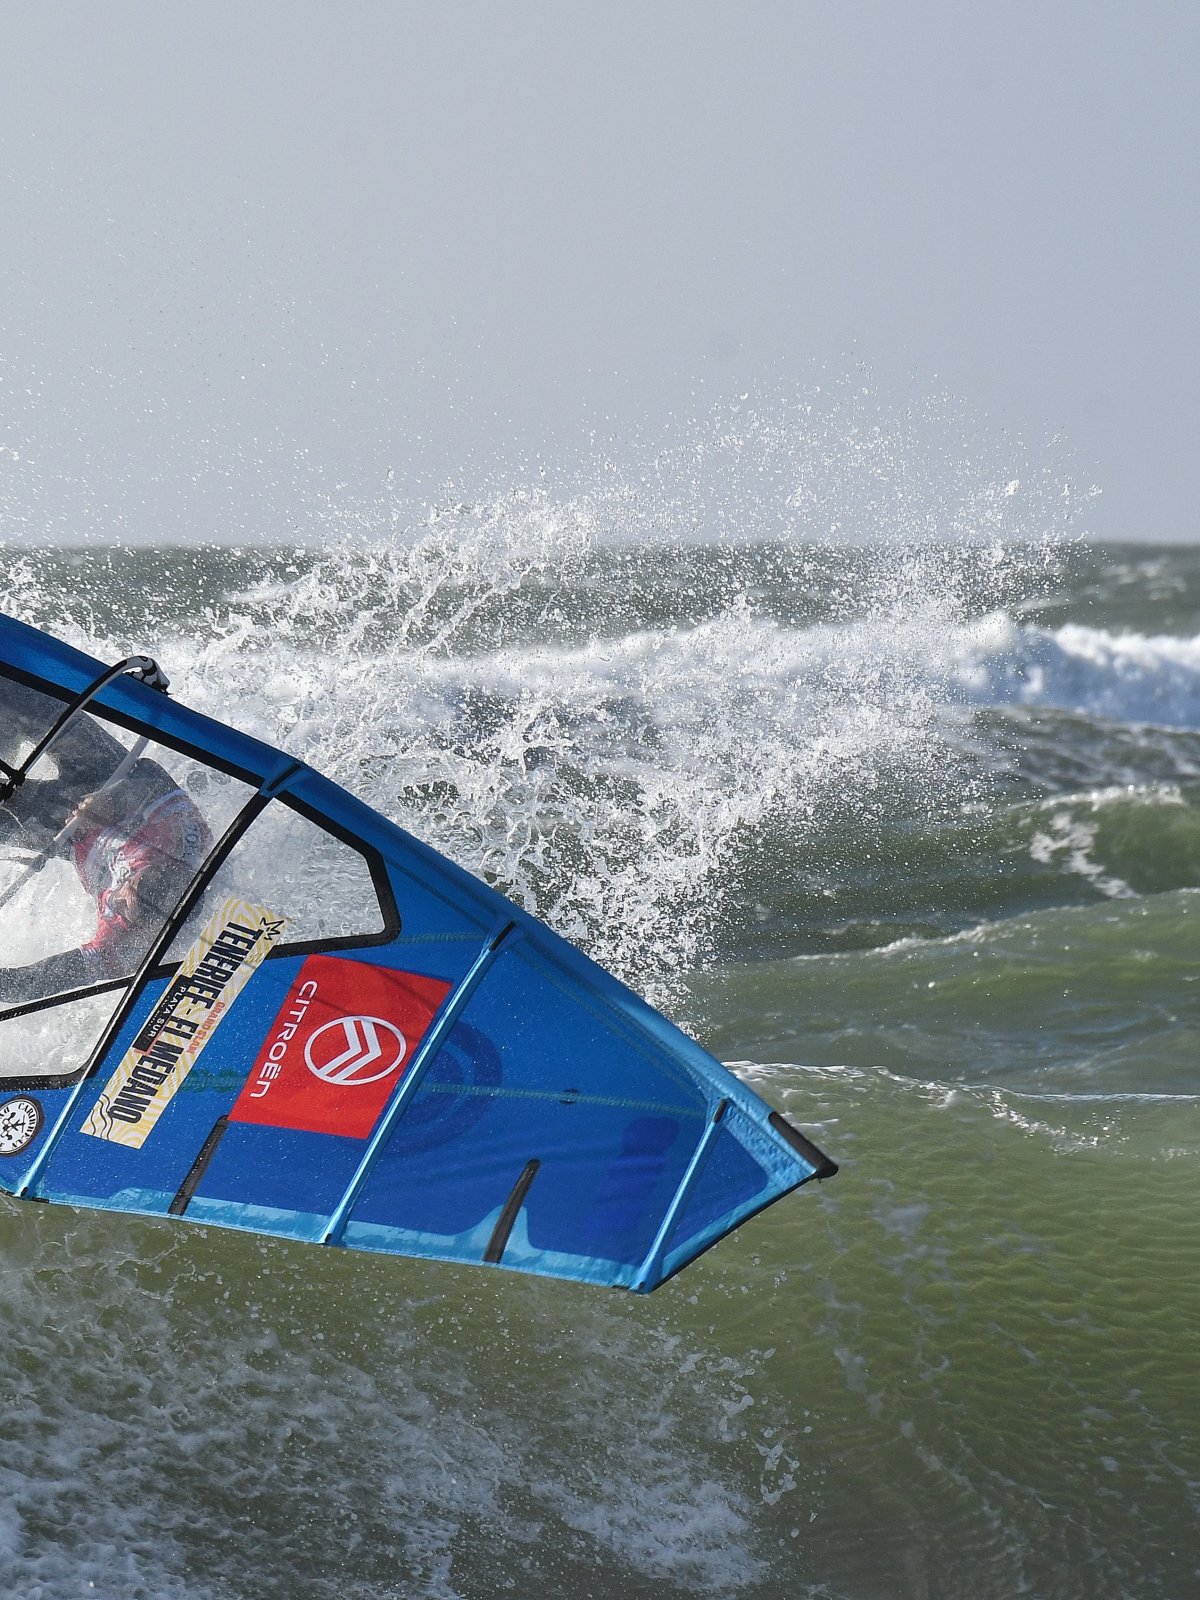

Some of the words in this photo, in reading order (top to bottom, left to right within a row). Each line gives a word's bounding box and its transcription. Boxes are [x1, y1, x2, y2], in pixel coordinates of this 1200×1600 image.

[183, 921, 263, 1009] TENERIFE
[163, 986, 187, 1014] PLAYA
[148, 1018, 164, 1038] SUR
[202, 1001, 225, 1030] GRAND
[187, 1030, 207, 1055] SLAM
[250, 980, 318, 1098] CITROËN
[109, 1040, 184, 1124] MÉDANO
